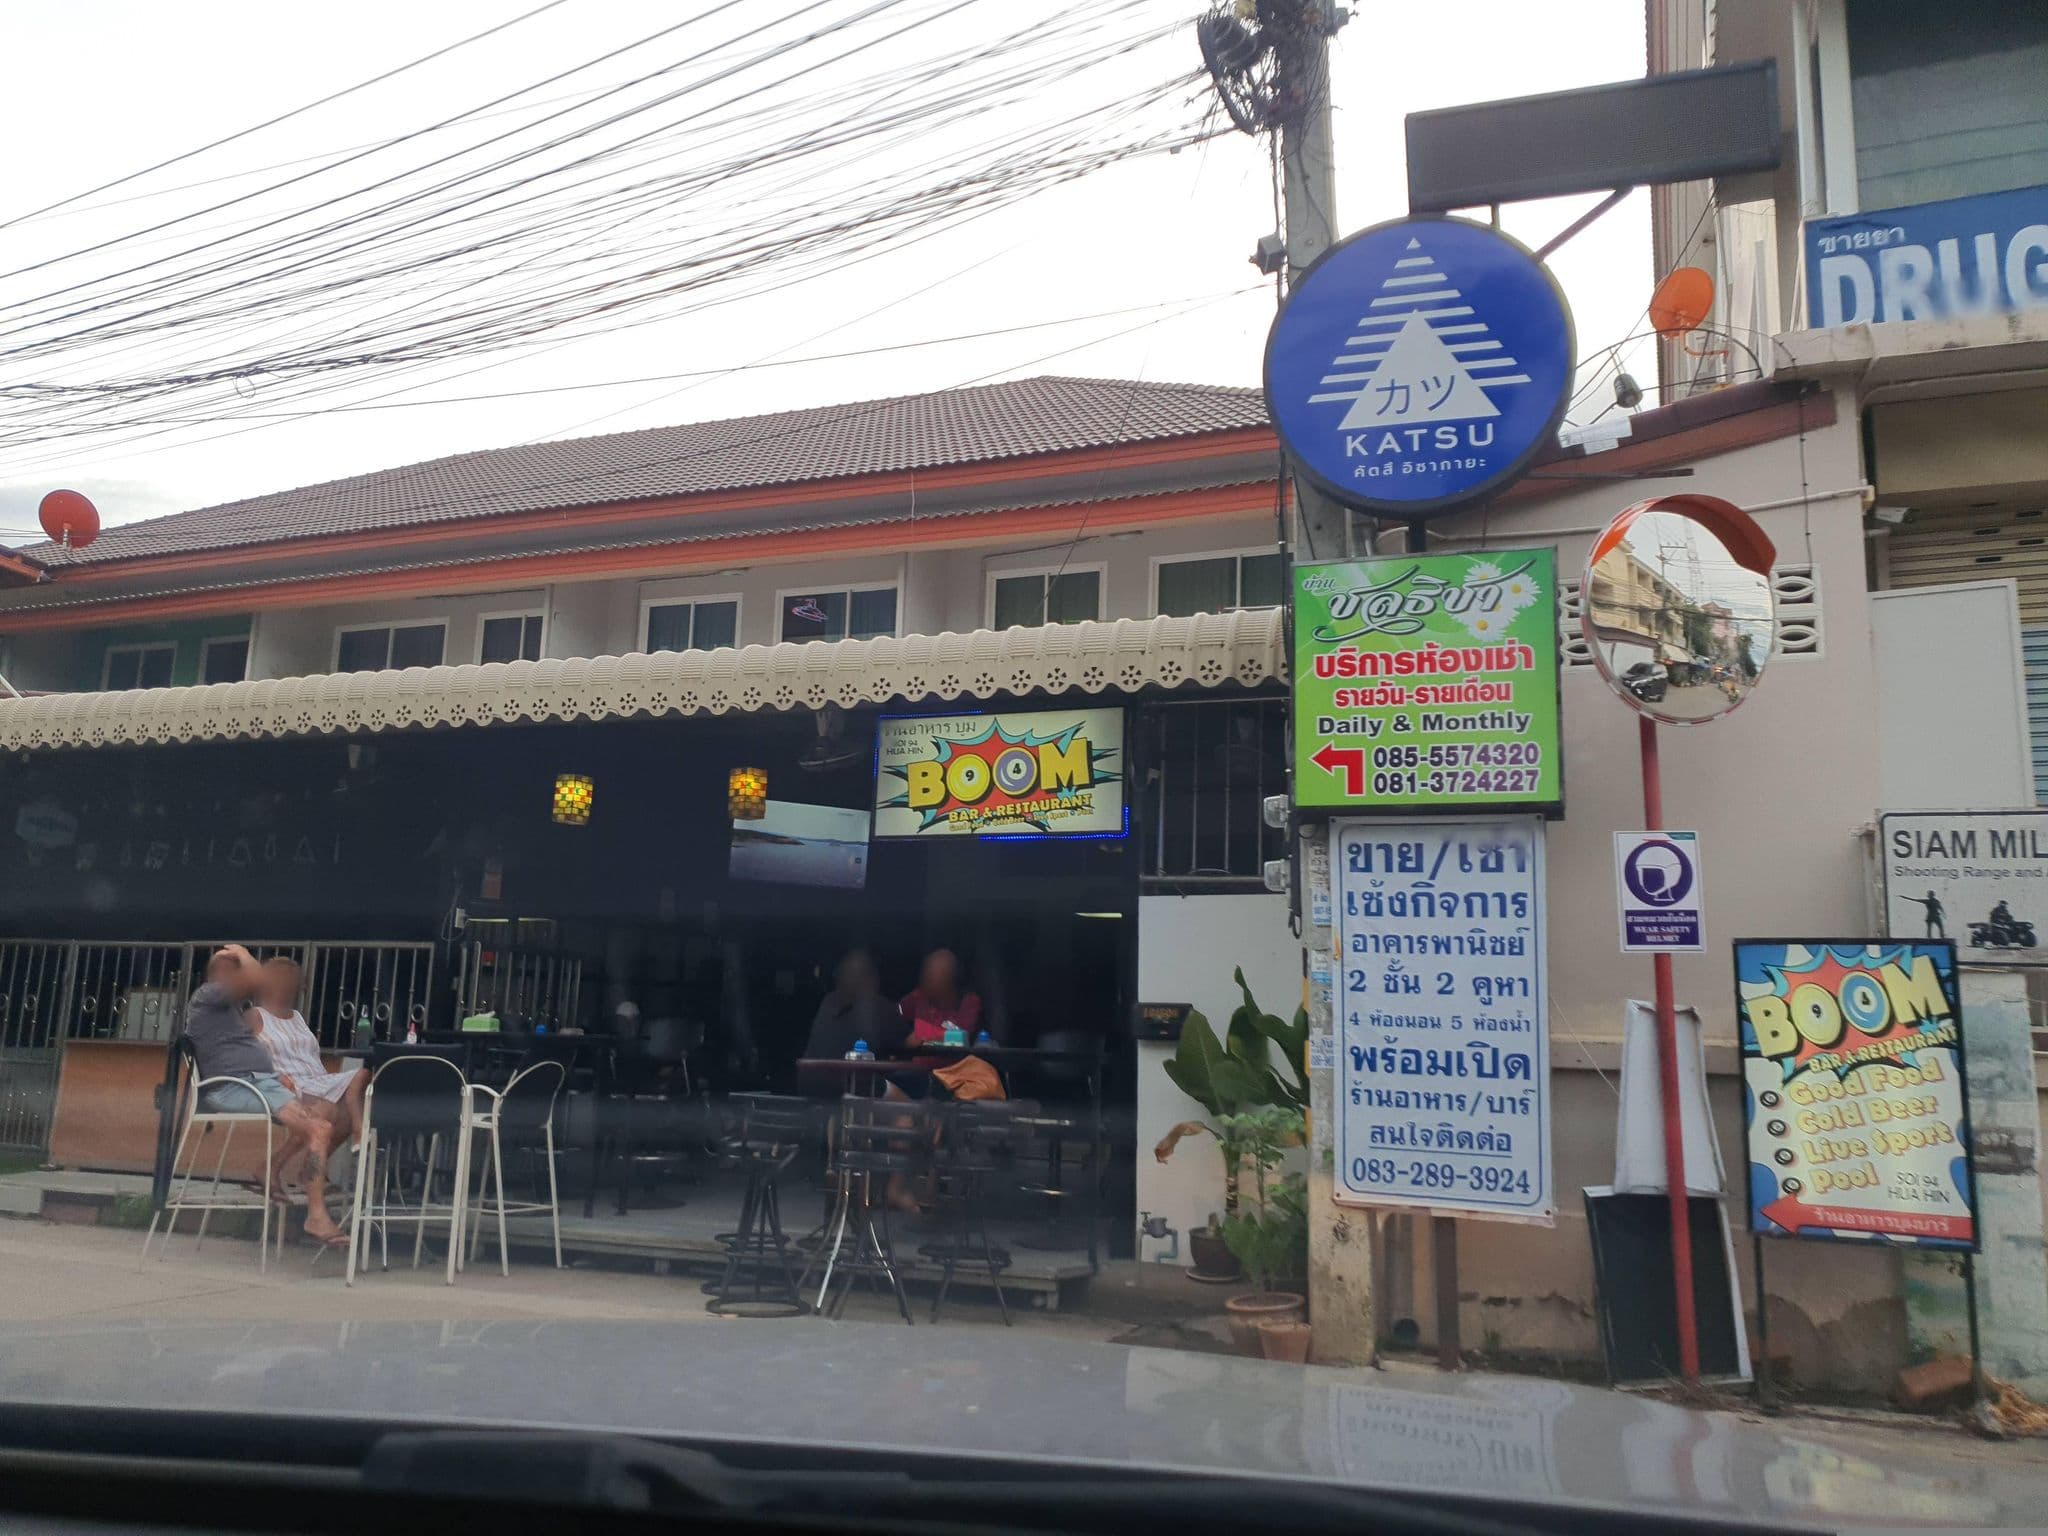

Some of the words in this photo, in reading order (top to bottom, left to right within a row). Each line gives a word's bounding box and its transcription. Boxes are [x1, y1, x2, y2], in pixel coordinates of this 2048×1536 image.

[1818, 226, 1905, 254] ขายยา
[1820, 225, 2048, 328] DRUG
[1375, 375, 1456, 416] カツ
[1345, 422, 1495, 457] KATSU
[1315, 638, 1534, 679] บริการห้องเช่า
[1334, 677, 1512, 707] รายวัน-รายเดือน
[1318, 715, 1382, 737] Daily
[1392, 714, 1412, 733] &
[1422, 711, 1531, 734] Monthly
[907, 737, 1091, 808] BOOM
[1374, 743, 1540, 768] 085-5574320
[1374, 770, 1540, 795] 081-3724227
[948, 808, 979, 823] BAR
[983, 807, 993, 818] &
[996, 794, 1092, 816] RESTAURANT
[1893, 830, 1977, 859] SIAM
[1895, 866, 1959, 880] Shooting
[1963, 866, 2011, 880] Range
[2015, 866, 2043, 878] and
[1347, 879, 1528, 918] เซ้งกิจการ
[1349, 969, 1366, 992] 2
[1383, 958, 1421, 994] ชั้น
[1437, 971, 1454, 995] 2
[1473, 975, 1529, 1006] คูหา
[1349, 1012, 1360, 1026] 4
[1370, 1008, 1442, 1029] ห้องนอน
[1451, 1015, 1463, 1030] 5
[1473, 1009, 1531, 1032] ห้องน้ำ
[1746, 954, 1952, 1059] BOOM
[1350, 1035, 1531, 1080] พร้อมเปิด
[1809, 1053, 1843, 1074] BAR
[1858, 1027, 1958, 1062] RESTAURANT
[1789, 1071, 1866, 1106] Good
[1867, 1056, 1945, 1092] Food
[1796, 1101, 1865, 1135] Cold
[1867, 1095, 1938, 1123] Beer
[1803, 1137, 1869, 1165] Live
[1871, 1121, 1954, 1156] Sport
[1352, 1158, 1530, 1194] 083-289-3924
[1810, 1160, 1880, 1194] Pool
[1888, 1186, 1920, 1201] HUA
[1924, 1188, 1950, 1204] HIN
